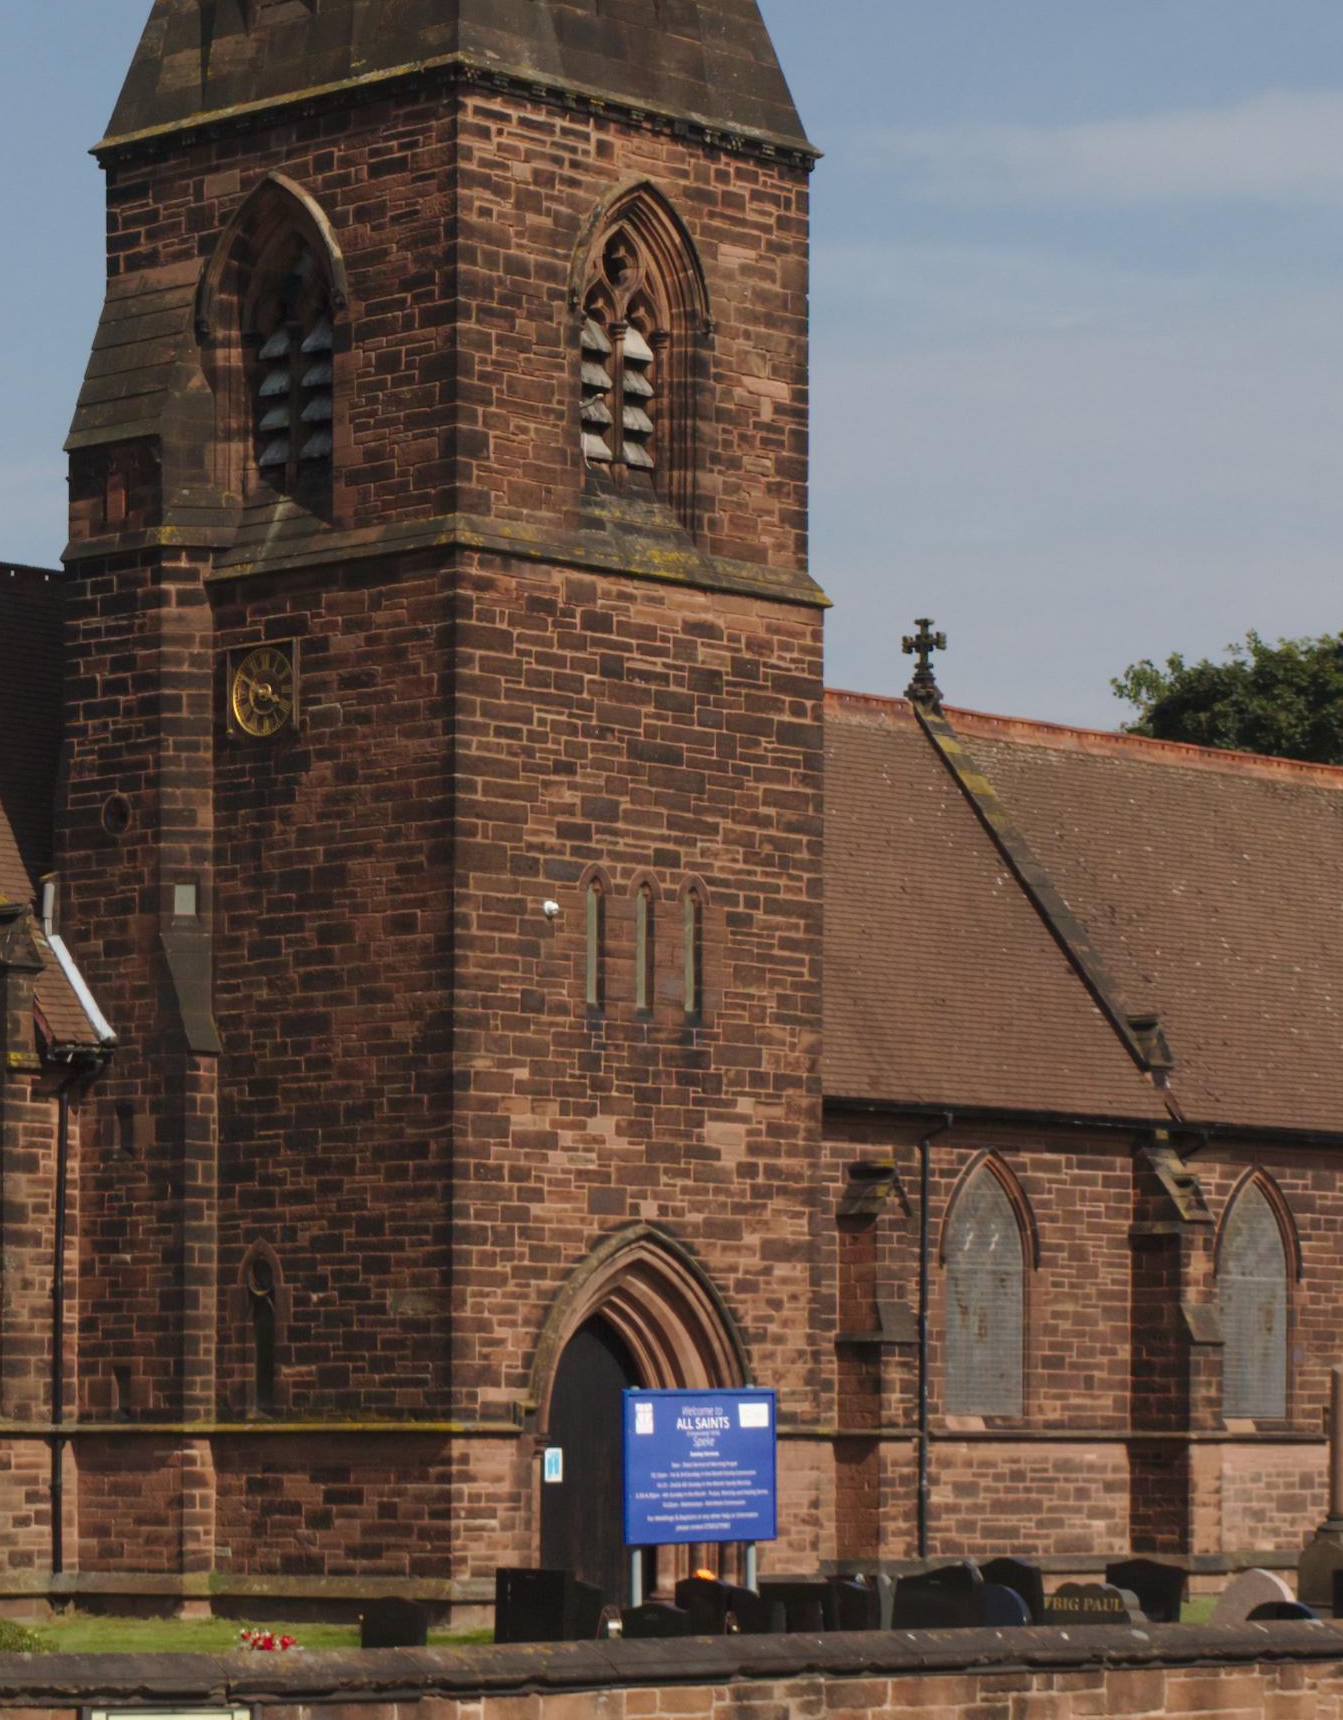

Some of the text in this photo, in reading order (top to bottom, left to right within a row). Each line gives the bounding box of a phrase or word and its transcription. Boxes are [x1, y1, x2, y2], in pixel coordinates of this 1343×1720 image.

[682, 1406, 723, 1416] Welcome to
[676, 1416, 730, 1430] ALL SAINTS
[693, 1437, 716, 1448] Speke
[1053, 1596, 1125, 1612] BIG PAUL
